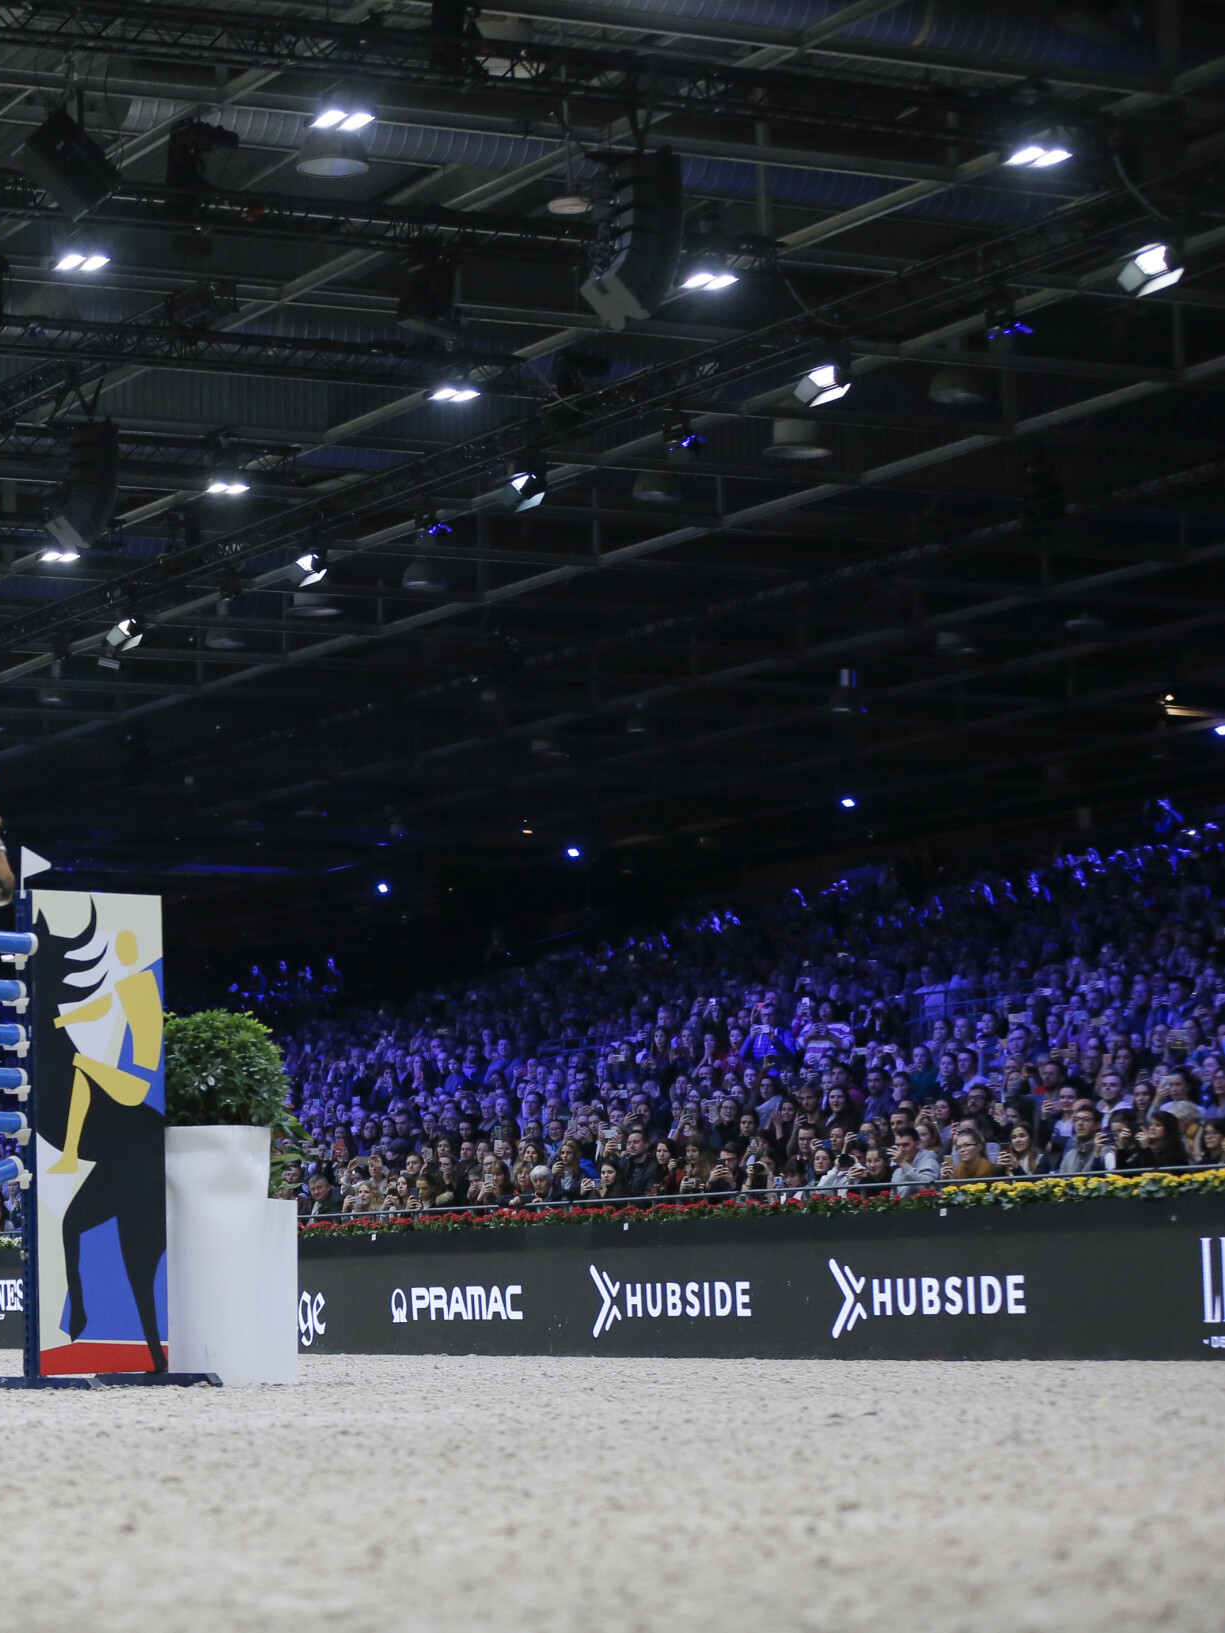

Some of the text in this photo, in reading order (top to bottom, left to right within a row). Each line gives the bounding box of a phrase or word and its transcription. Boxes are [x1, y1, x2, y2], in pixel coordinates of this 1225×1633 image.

[411, 1285, 524, 1321] PRAMAC
[625, 1281, 752, 1317] HUBSIDE
[872, 1275, 1027, 1316] HUBSIDE
